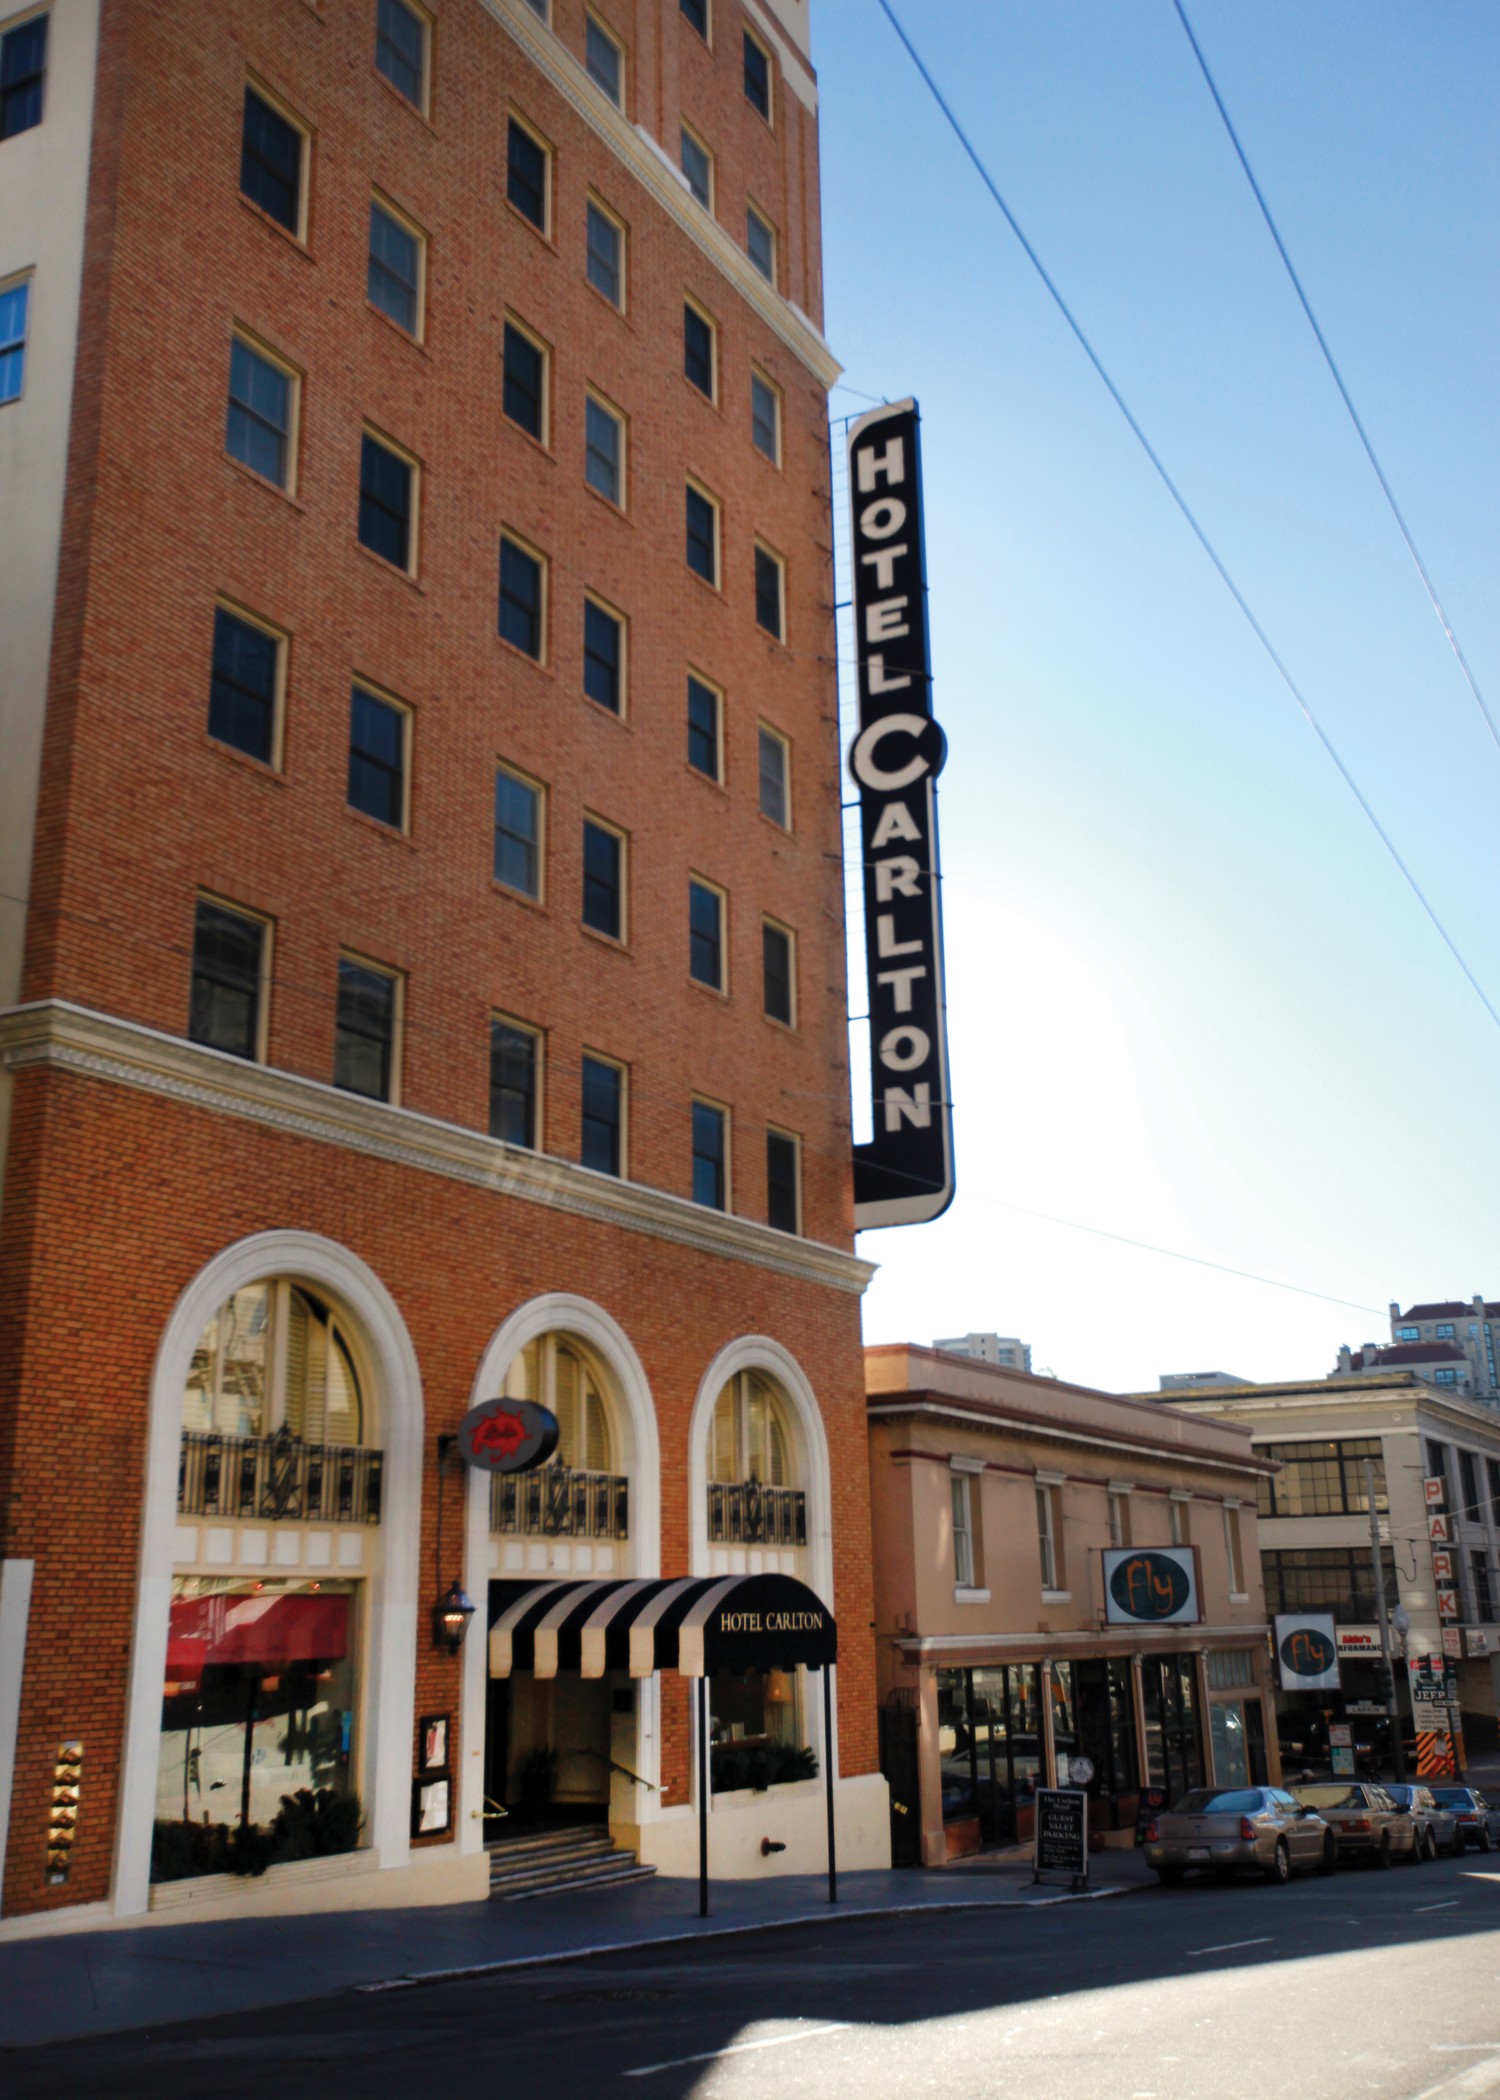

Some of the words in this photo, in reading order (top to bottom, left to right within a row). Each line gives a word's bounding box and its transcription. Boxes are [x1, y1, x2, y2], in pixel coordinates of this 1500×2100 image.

[856, 436, 912, 696] HOTEL
[854, 712, 932, 1132] CARLTON
[1425, 1481, 1456, 1613] PARK
[1127, 1560, 1173, 1613] Fly
[721, 1612, 763, 1632] HOTEL
[766, 1611, 823, 1630] CARLTON
[1291, 1633, 1325, 1672] Fly
[1415, 1690, 1446, 1701] JEEP
[1048, 1813, 1074, 1822] GUEST
[1048, 1822, 1074, 1831] VALET
[1043, 1830, 1080, 1840] PARKING
